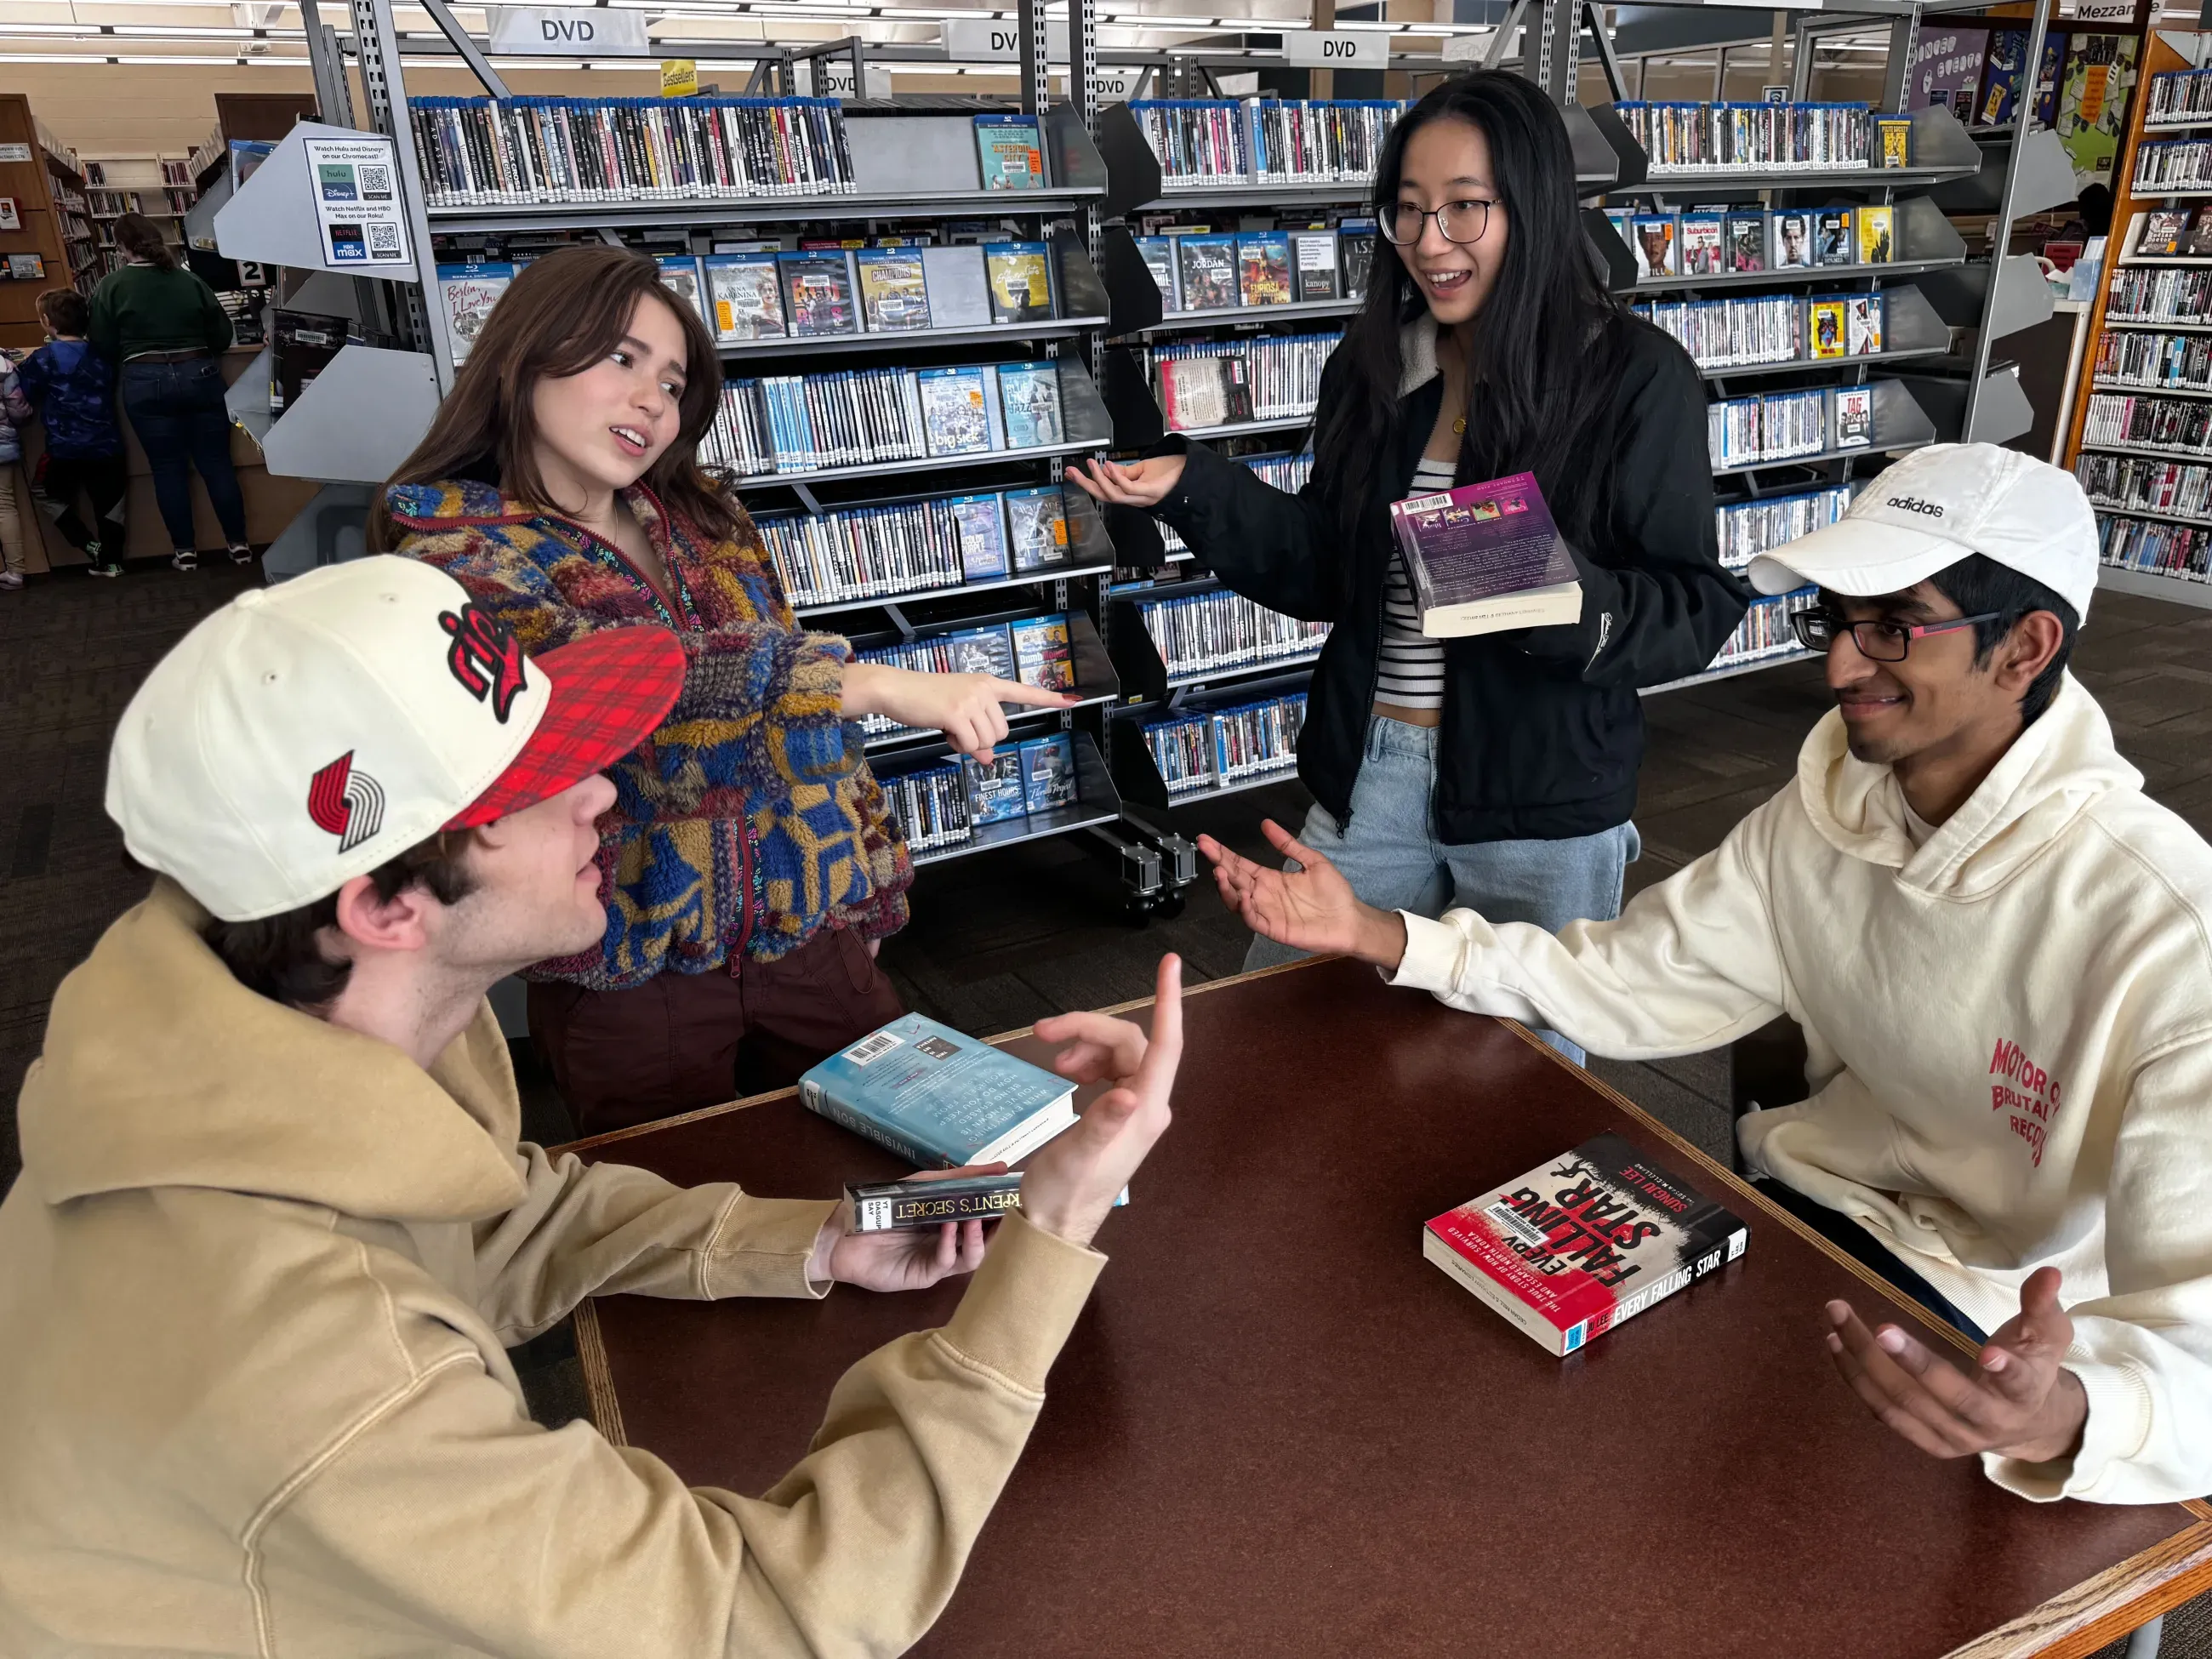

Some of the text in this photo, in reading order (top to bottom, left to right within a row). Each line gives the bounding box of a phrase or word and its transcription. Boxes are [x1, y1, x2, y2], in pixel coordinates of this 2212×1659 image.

[541, 20, 595, 42] DVD
[991, 32, 1018, 51] DV
[1324, 40, 1356, 58] DVD
[663, 69, 695, 88] Bestsellers
[827, 77, 857, 92] DVD
[1097, 80, 1124, 94] DVD
[498, 135, 512, 185] AGENT GAME
[697, 143, 705, 166] ANIARA
[715, 138, 727, 178] ANTHROPOID
[795, 134, 806, 174] AUTOMATA
[506, 141, 521, 191] ALEX CROSS
[337, 248, 362, 257] max
[243, 262, 261, 280] 2
[1192, 259, 1224, 269] JORDAN
[1649, 267, 1665, 276] TILL
[872, 266, 911, 282] CHAMPIONS
[448, 282, 481, 300] Berlin,
[1251, 282, 1280, 294] FURIOSA
[1305, 279, 1330, 288] kanopy
[461, 298, 481, 312] Love
[480, 290, 497, 306] You
[1006, 383, 1029, 394] BLUE
[1007, 393, 1031, 404] LIKE
[1847, 397, 1862, 413] TAG
[1009, 404, 1031, 414] JAZZ
[936, 433, 979, 448] big sick
[1887, 497, 1943, 517] adidas
[961, 543, 984, 555] PURPLE
[965, 534, 984, 546] COLOR
[1019, 652, 1042, 664] Dumb
[975, 785, 1019, 801] FINEST HOURS
[915, 1035, 938, 1049] AMERICA
[934, 1050, 948, 1058] THIS
[1989, 1038, 2047, 1096] MOTOR
[957, 1070, 1003, 1100] YOURSELF
[995, 1073, 1018, 1087] HOW
[980, 1086, 997, 1097] DO
[992, 1082, 1021, 1101] BEING
[1003, 1083, 1037, 1106] YOU'VE
[1020, 1087, 1049, 1105] WHEN
[931, 1098, 959, 1117] FROM
[961, 1096, 983, 1110] YOU
[1992, 1085, 2050, 1123] BRUTAL
[936, 1109, 962, 1126] KEEP
[966, 1104, 1023, 1143] EVERYTHING
[970, 1104, 1006, 1128] KNOWN
[833, 1109, 915, 1160] INVISIBLE SON
[1616, 1165, 1689, 1213] SUNGJU LEE
[883, 1200, 888, 1211] YT
[896, 1193, 1023, 1219] RPENT'S SECRET
[1548, 1176, 1665, 1253] STAR
[1446, 1226, 1482, 1252] SURVIVED
[1494, 1183, 1642, 1289] FALLING
[1481, 1253, 1500, 1266] HOW
[1500, 1229, 1568, 1277] EVERY
[1451, 1257, 1474, 1281] LIBRARIES
[1465, 1230, 1558, 1299] AND ESCAPED NORTH KOREA
[1496, 1263, 1509, 1273] OF
[1505, 1270, 1531, 1289] STORY
[1614, 1249, 1721, 1324] EVERY FALLING STAR
[1525, 1286, 1548, 1303] TRUE
[1544, 1300, 1562, 1313] THE
[1510, 1308, 1526, 1326] CEDAR
[1597, 1313, 1609, 1327] LEE
